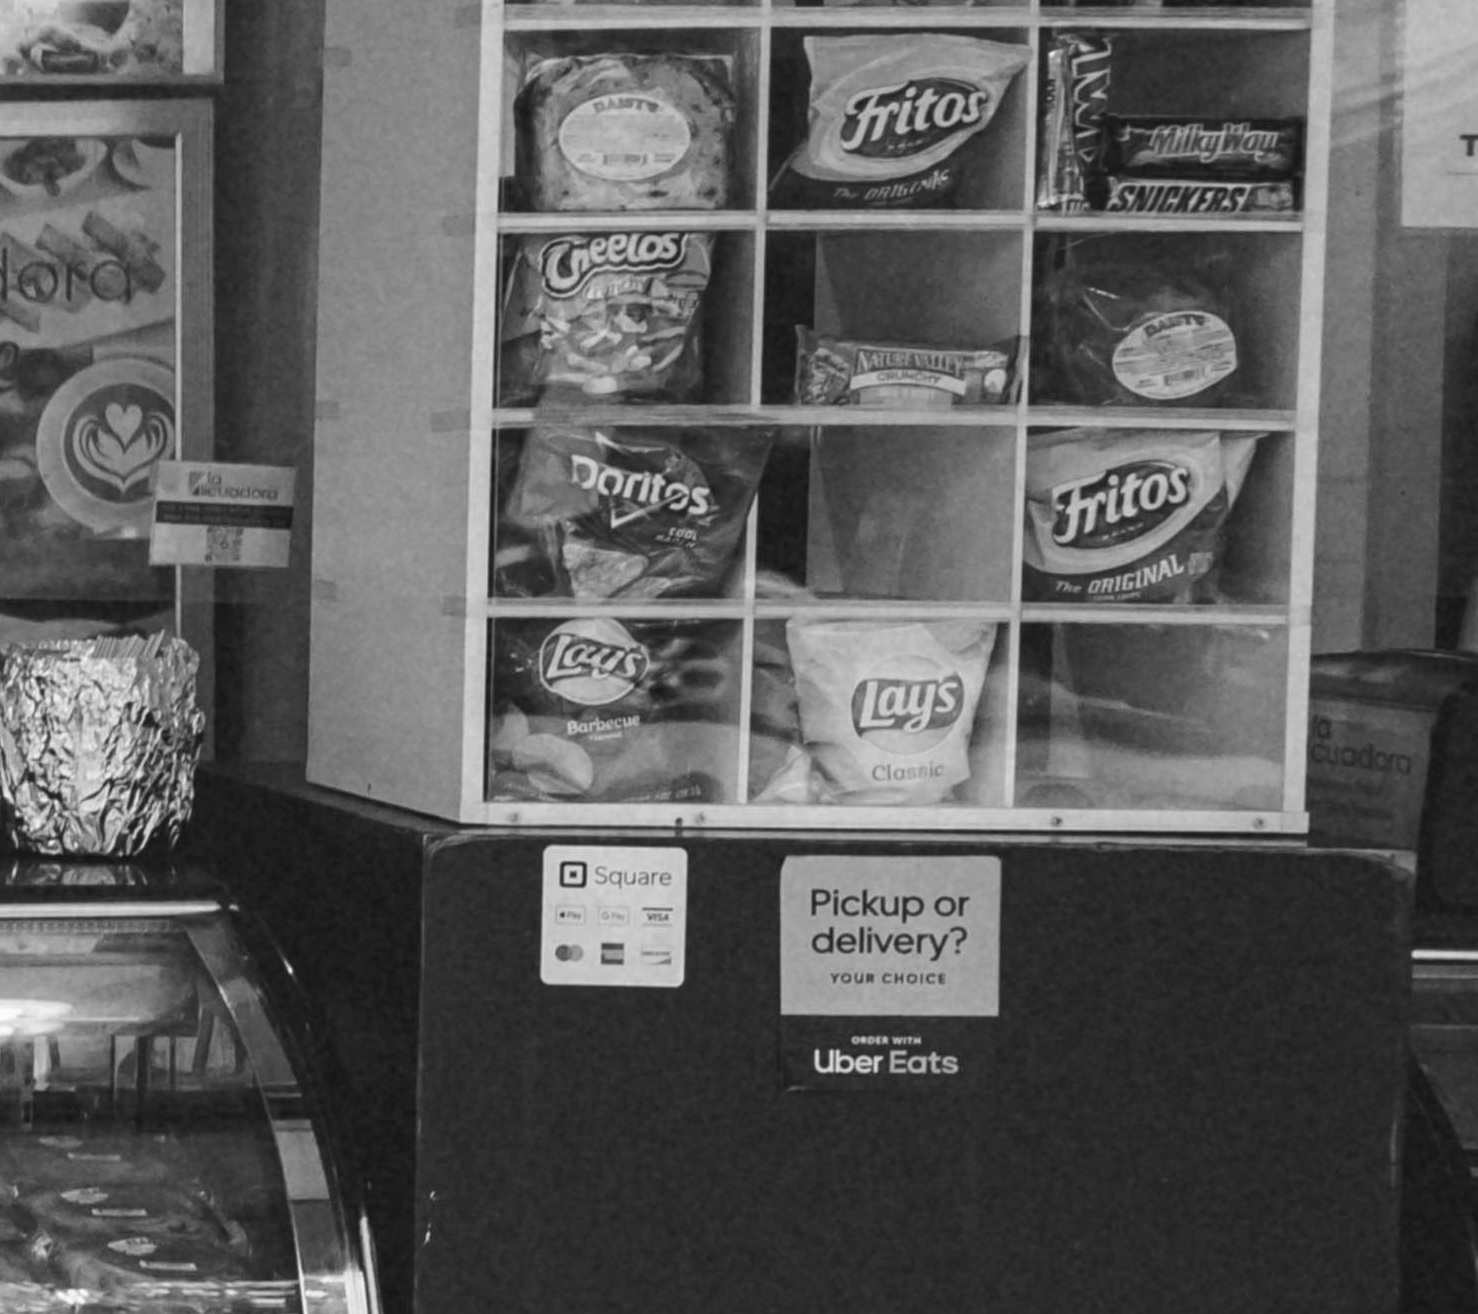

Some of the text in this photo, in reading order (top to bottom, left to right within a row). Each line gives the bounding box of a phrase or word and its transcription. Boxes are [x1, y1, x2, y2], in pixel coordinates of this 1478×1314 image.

[841, 82, 987, 152] Fritos
[1115, 185, 1247, 213] SNICKERS
[857, 349, 910, 374] NATURE
[876, 370, 941, 384] CRUNCHY
[571, 454, 710, 515] Doritos
[1053, 467, 1188, 544] Fritos
[1056, 554, 1184, 594] The ORIGINAL
[546, 634, 644, 679] Lay's
[859, 679, 959, 733] Lay's
[566, 714, 641, 736] Barbecue
[871, 760, 945, 782] Classic
[1311, 744, 1412, 775] cuadora
[594, 865, 672, 890] Square
[646, 913, 670, 922] VISA
[811, 889, 971, 924] Pickup or
[811, 926, 968, 962] delivery?
[830, 972, 946, 985] YOUR CHOICE
[851, 1036, 922, 1045] ORDER WITH
[814, 1048, 960, 1074] Uber Eats
